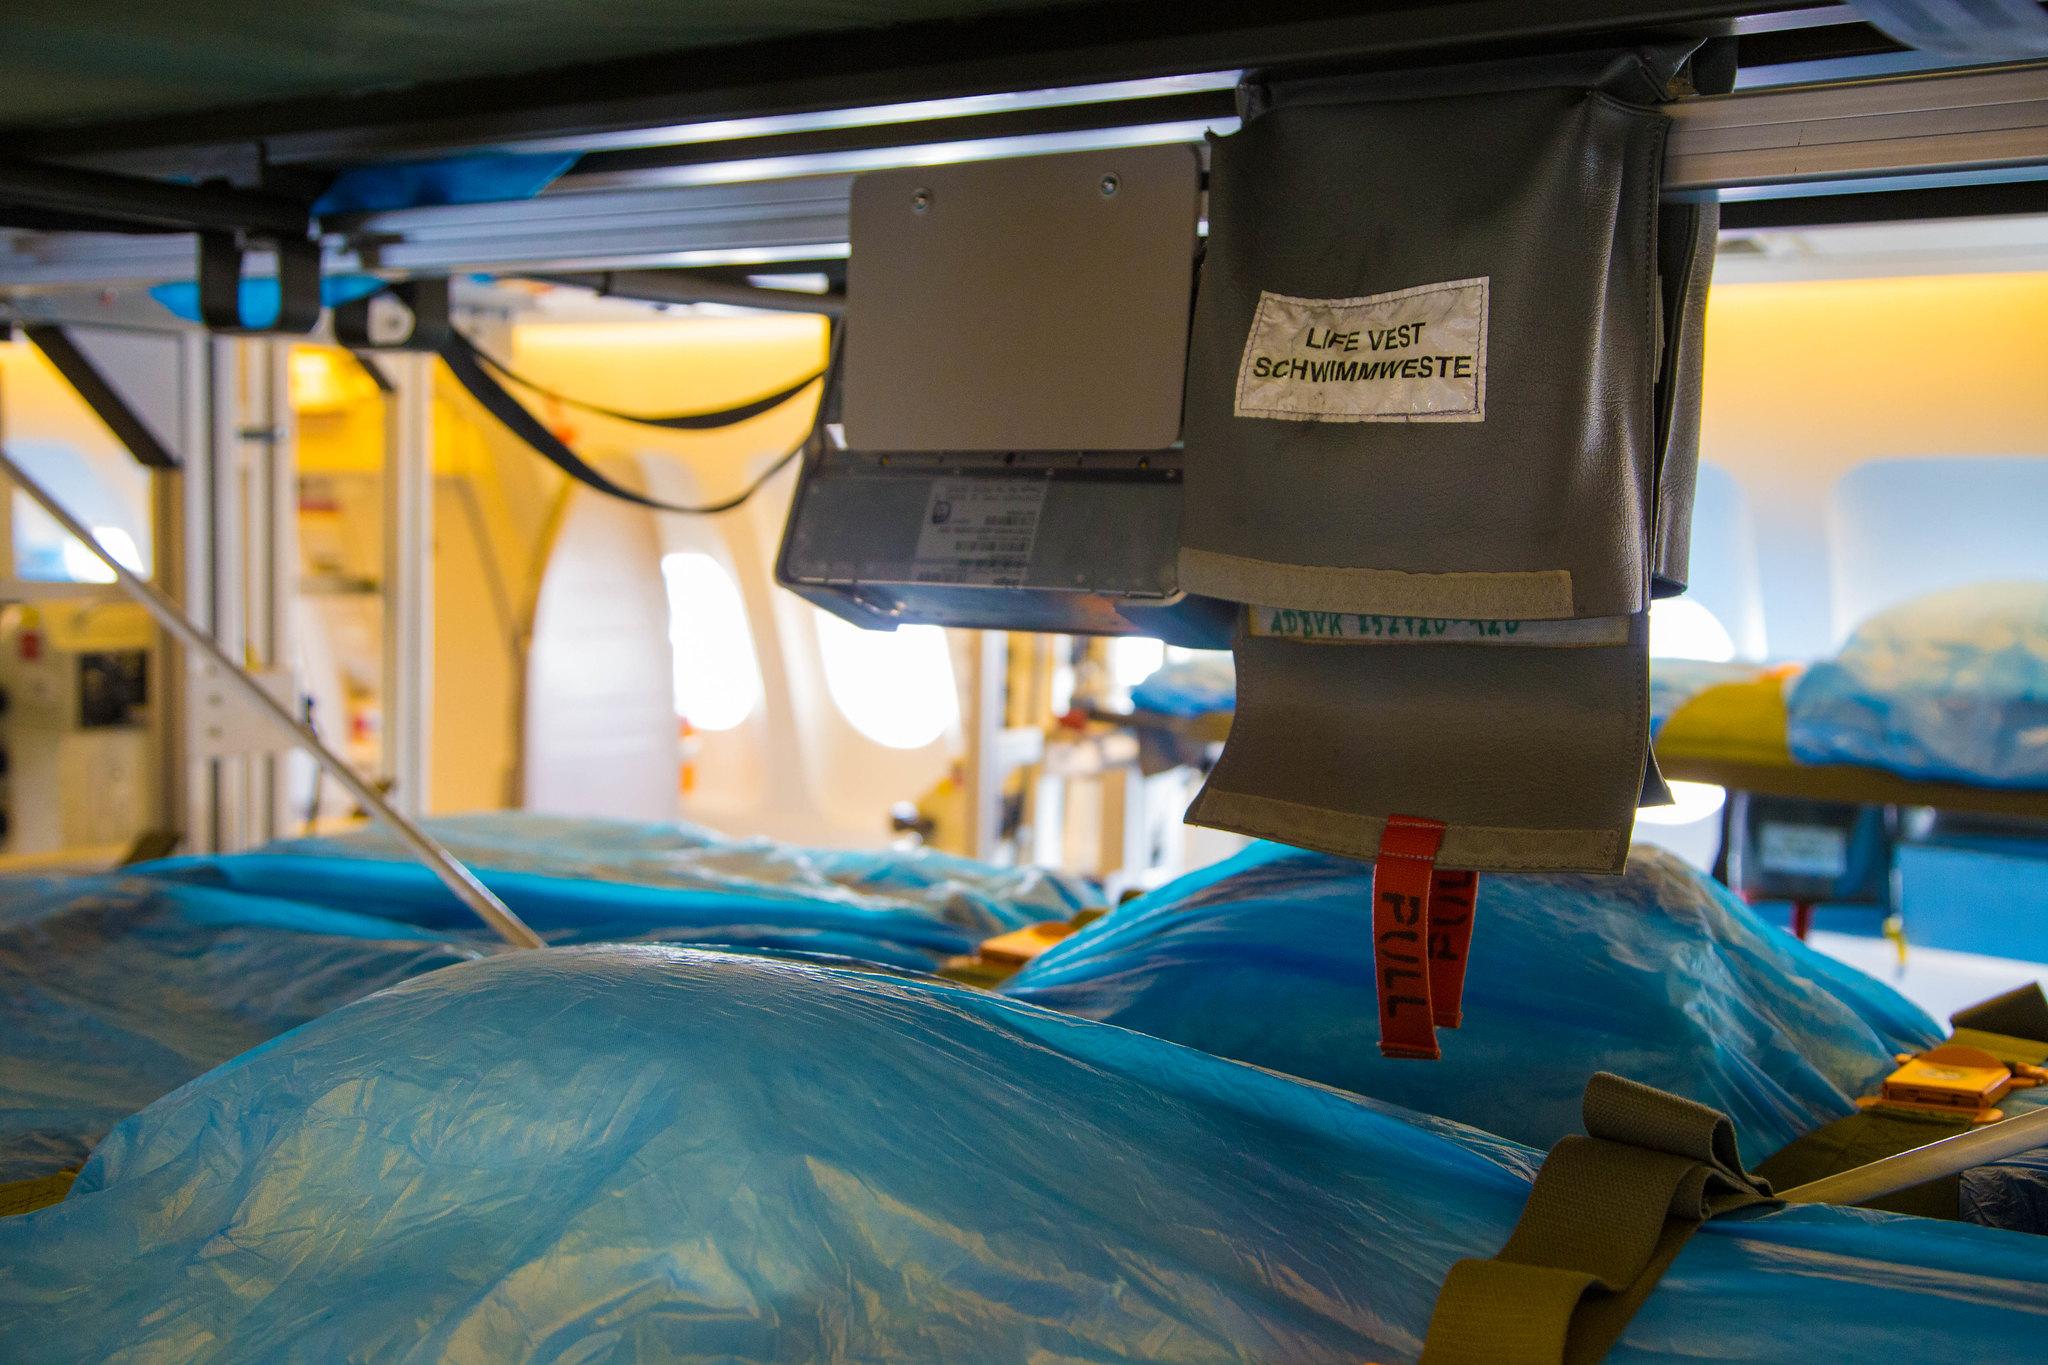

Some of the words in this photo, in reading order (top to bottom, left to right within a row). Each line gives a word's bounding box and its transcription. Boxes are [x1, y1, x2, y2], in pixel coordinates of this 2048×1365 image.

[1305, 327, 1360, 352] LIFE
[1368, 322, 1427, 351] VEST
[1252, 355, 1472, 383] SCHWIMMWESTE
[1380, 891, 1427, 1019] PULL
